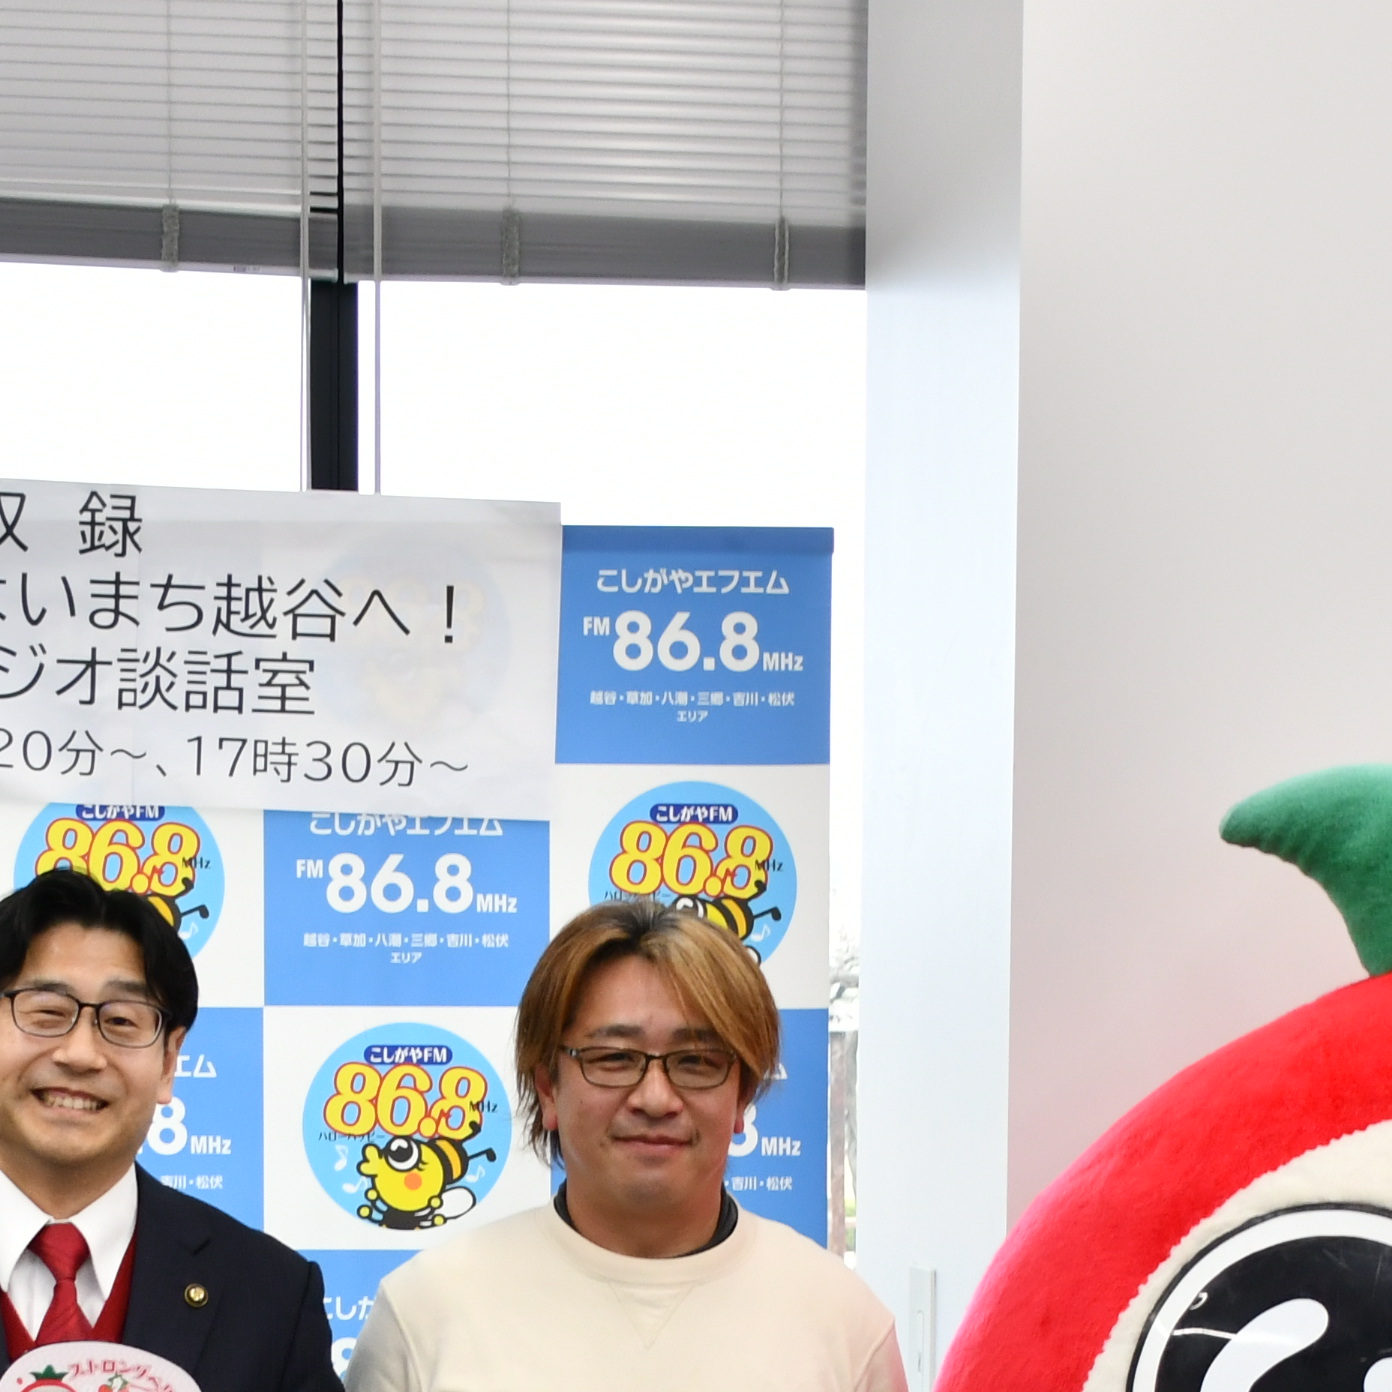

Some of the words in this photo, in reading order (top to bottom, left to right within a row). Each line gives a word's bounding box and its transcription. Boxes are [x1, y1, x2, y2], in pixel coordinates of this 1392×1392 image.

[596, 568, 790, 594] こしがやエフエム
[583, 616, 610, 636] FM
[613, 610, 760, 672] 86.8
[762, 652, 804, 671] MHz
[677, 711, 709, 723] エリア
[656, 806, 733, 822] こしがやFM
[609, 819, 774, 899] 86.8
[296, 859, 324, 878] FM
[326, 852, 474, 914] 86.8
[476, 893, 518, 913] MHz
[390, 952, 422, 964] エリア
[370, 1046, 448, 1064] こしがやFM
[323, 1061, 488, 1141] 86.8
[468, 1100, 498, 1114] MHz
[190, 1135, 232, 1155] MHz
[761, 1136, 802, 1157] MHz
